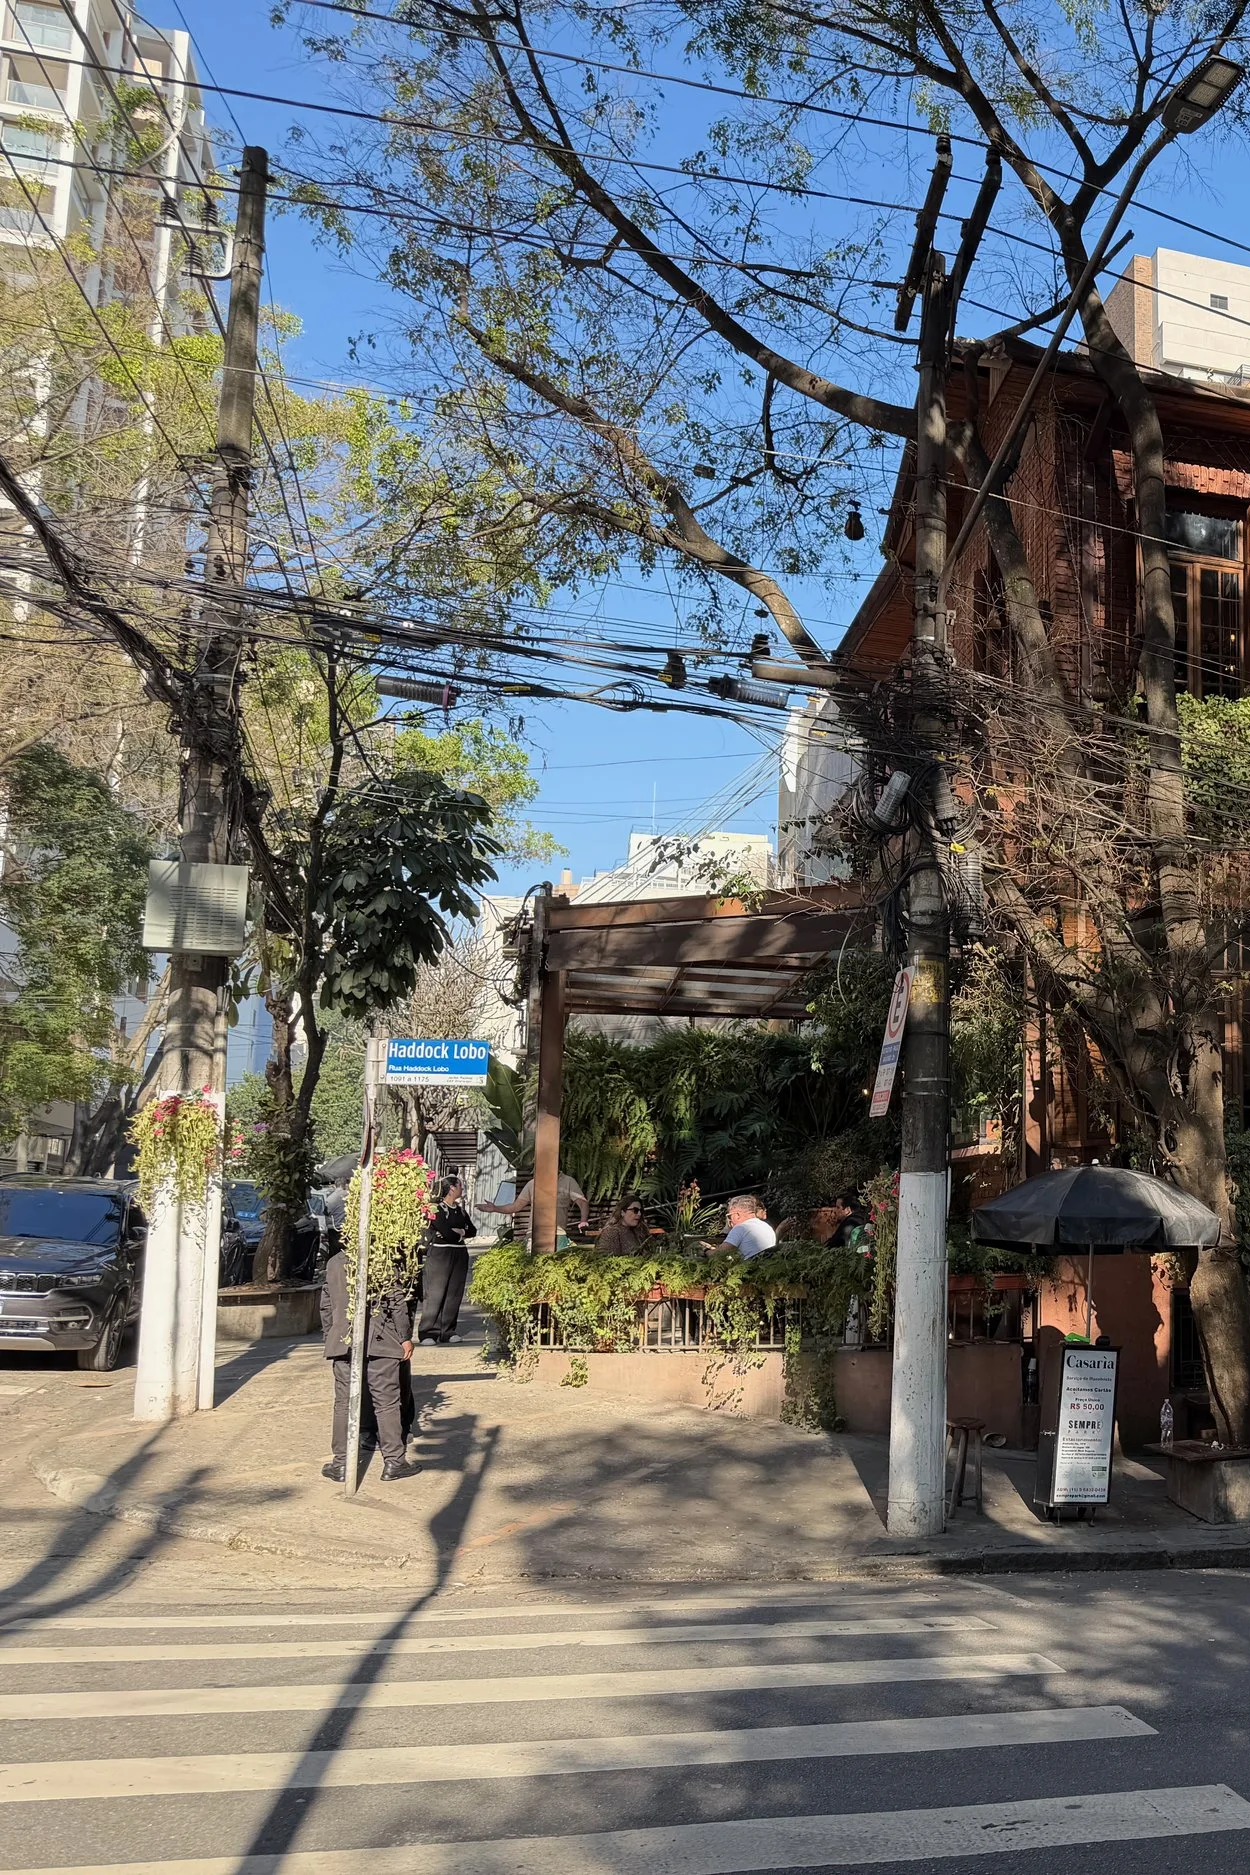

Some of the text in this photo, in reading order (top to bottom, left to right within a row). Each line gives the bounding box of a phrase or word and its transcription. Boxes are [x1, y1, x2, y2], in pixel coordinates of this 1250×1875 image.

[389, 1042, 486, 1060] Haddock Lobo
[1083, 1403, 1105, 1411] 50,00
[1068, 1420, 1101, 1429] SEMPRE
